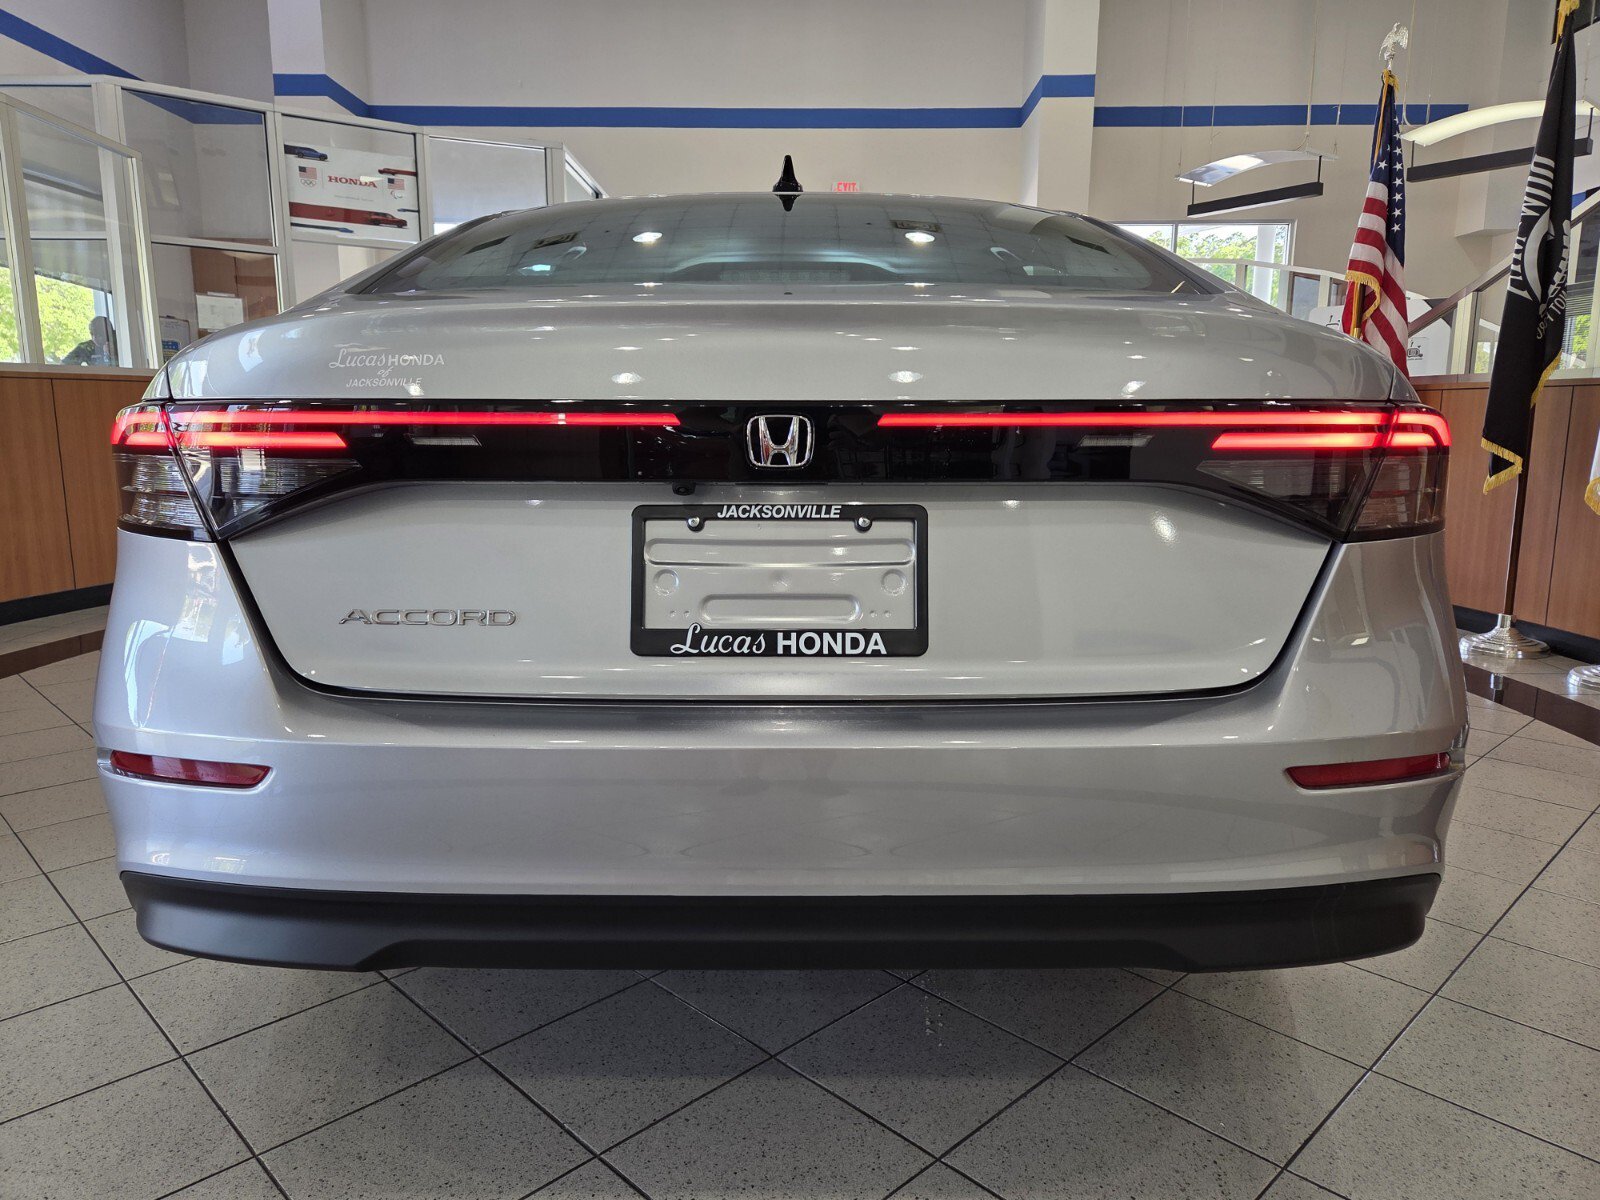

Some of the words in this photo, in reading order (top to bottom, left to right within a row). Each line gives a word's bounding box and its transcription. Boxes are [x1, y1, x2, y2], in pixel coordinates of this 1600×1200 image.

[328, 348, 386, 368] Lucas
[387, 353, 445, 366] HONDA
[376, 366, 394, 378] of
[345, 377, 422, 388] JACKSONVILLE
[717, 505, 842, 519] JACKSONVILLE
[338, 609, 517, 627] ACCORD
[670, 622, 766, 655] Lucas
[777, 632, 887, 655] HONDA
